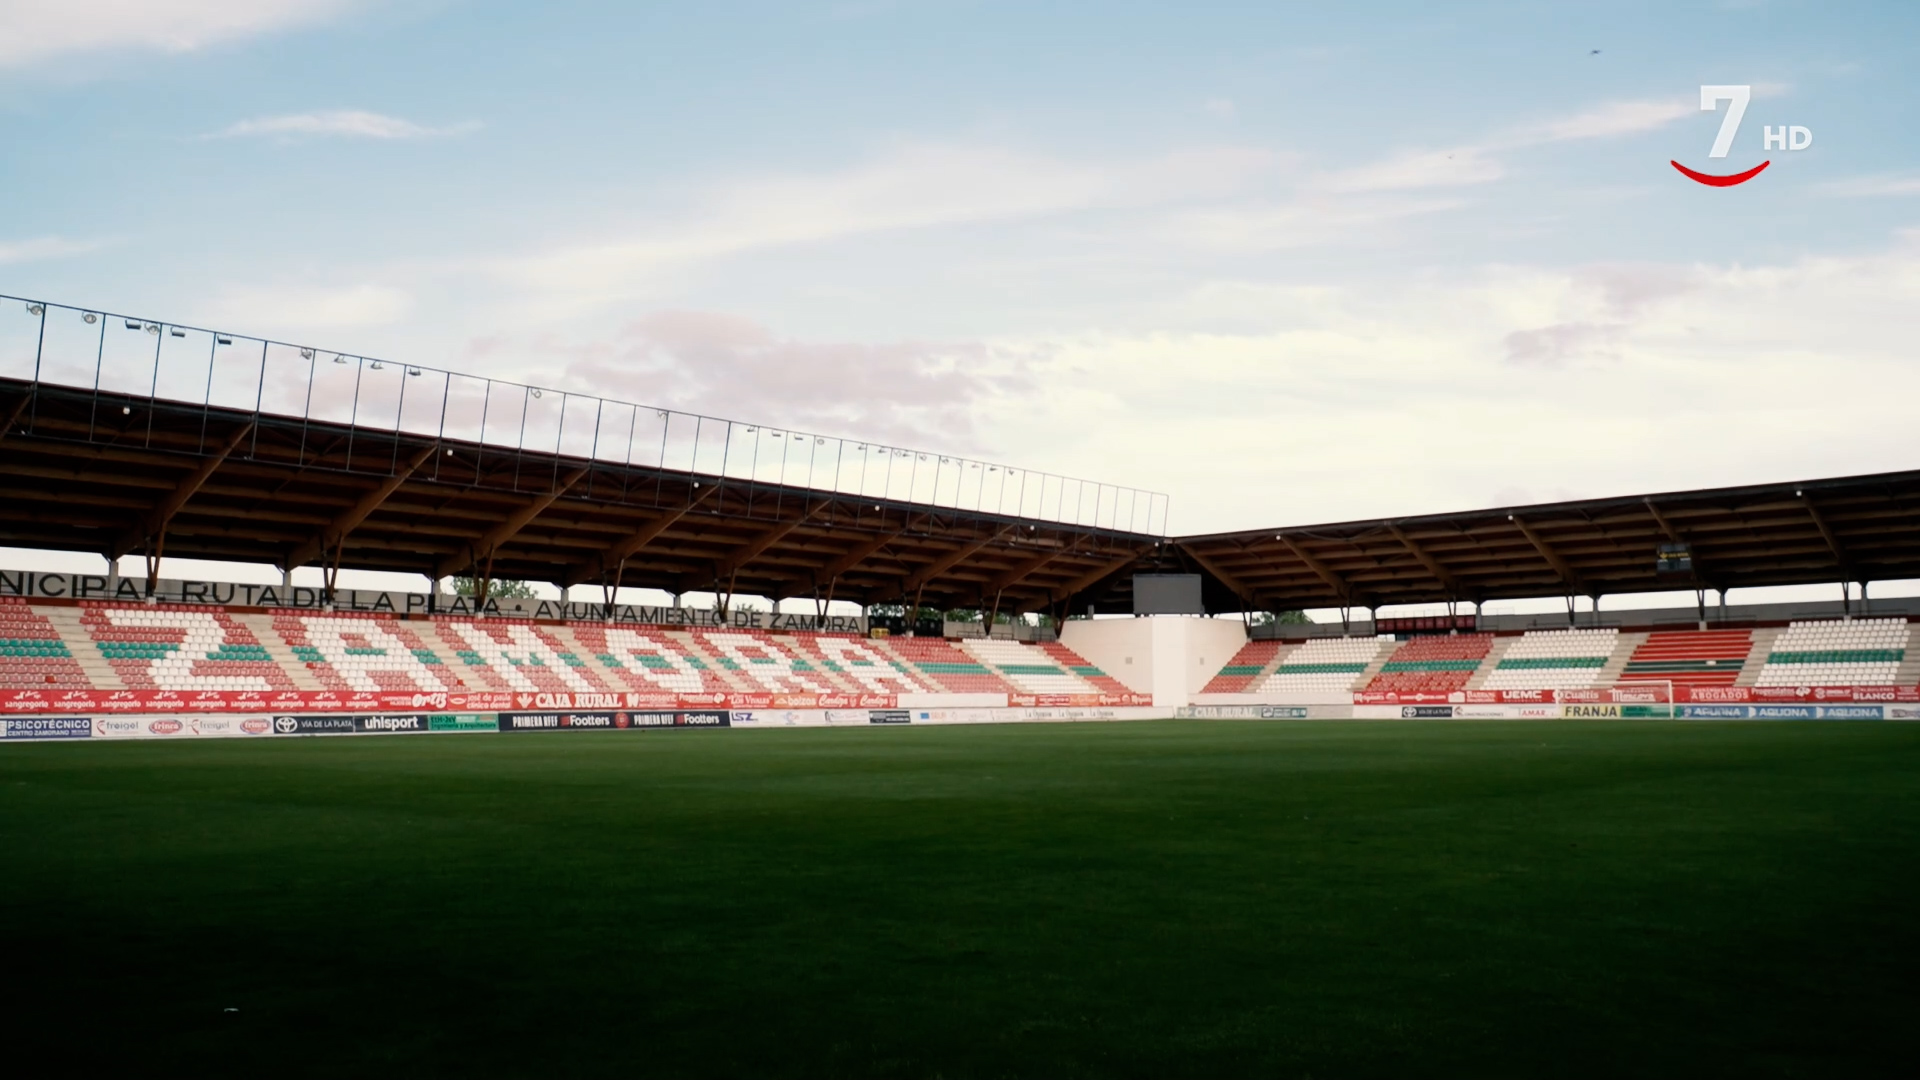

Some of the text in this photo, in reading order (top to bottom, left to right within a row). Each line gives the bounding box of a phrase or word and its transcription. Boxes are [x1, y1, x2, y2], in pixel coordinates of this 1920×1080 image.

[182, 581, 281, 606] RUTA
[352, 590, 395, 612] LA
[735, 612, 762, 628] DE
[770, 613, 860, 632] ZAMORA
[535, 692, 622, 708] CAJA RURAL
[1502, 691, 1542, 699] UEMC
[1853, 692, 1895, 700] BLANCO
[1565, 706, 1617, 717] FRANJA
[1760, 708, 1808, 717] AQUONA
[1827, 708, 1879, 717] AQUONA
[8, 718, 90, 729] PSICOTÉCNICO
[365, 716, 418, 731] uhlsport
[512, 716, 543, 727] PRIMERA
[570, 715, 610, 726] Footters
[684, 714, 720, 724] Footters
